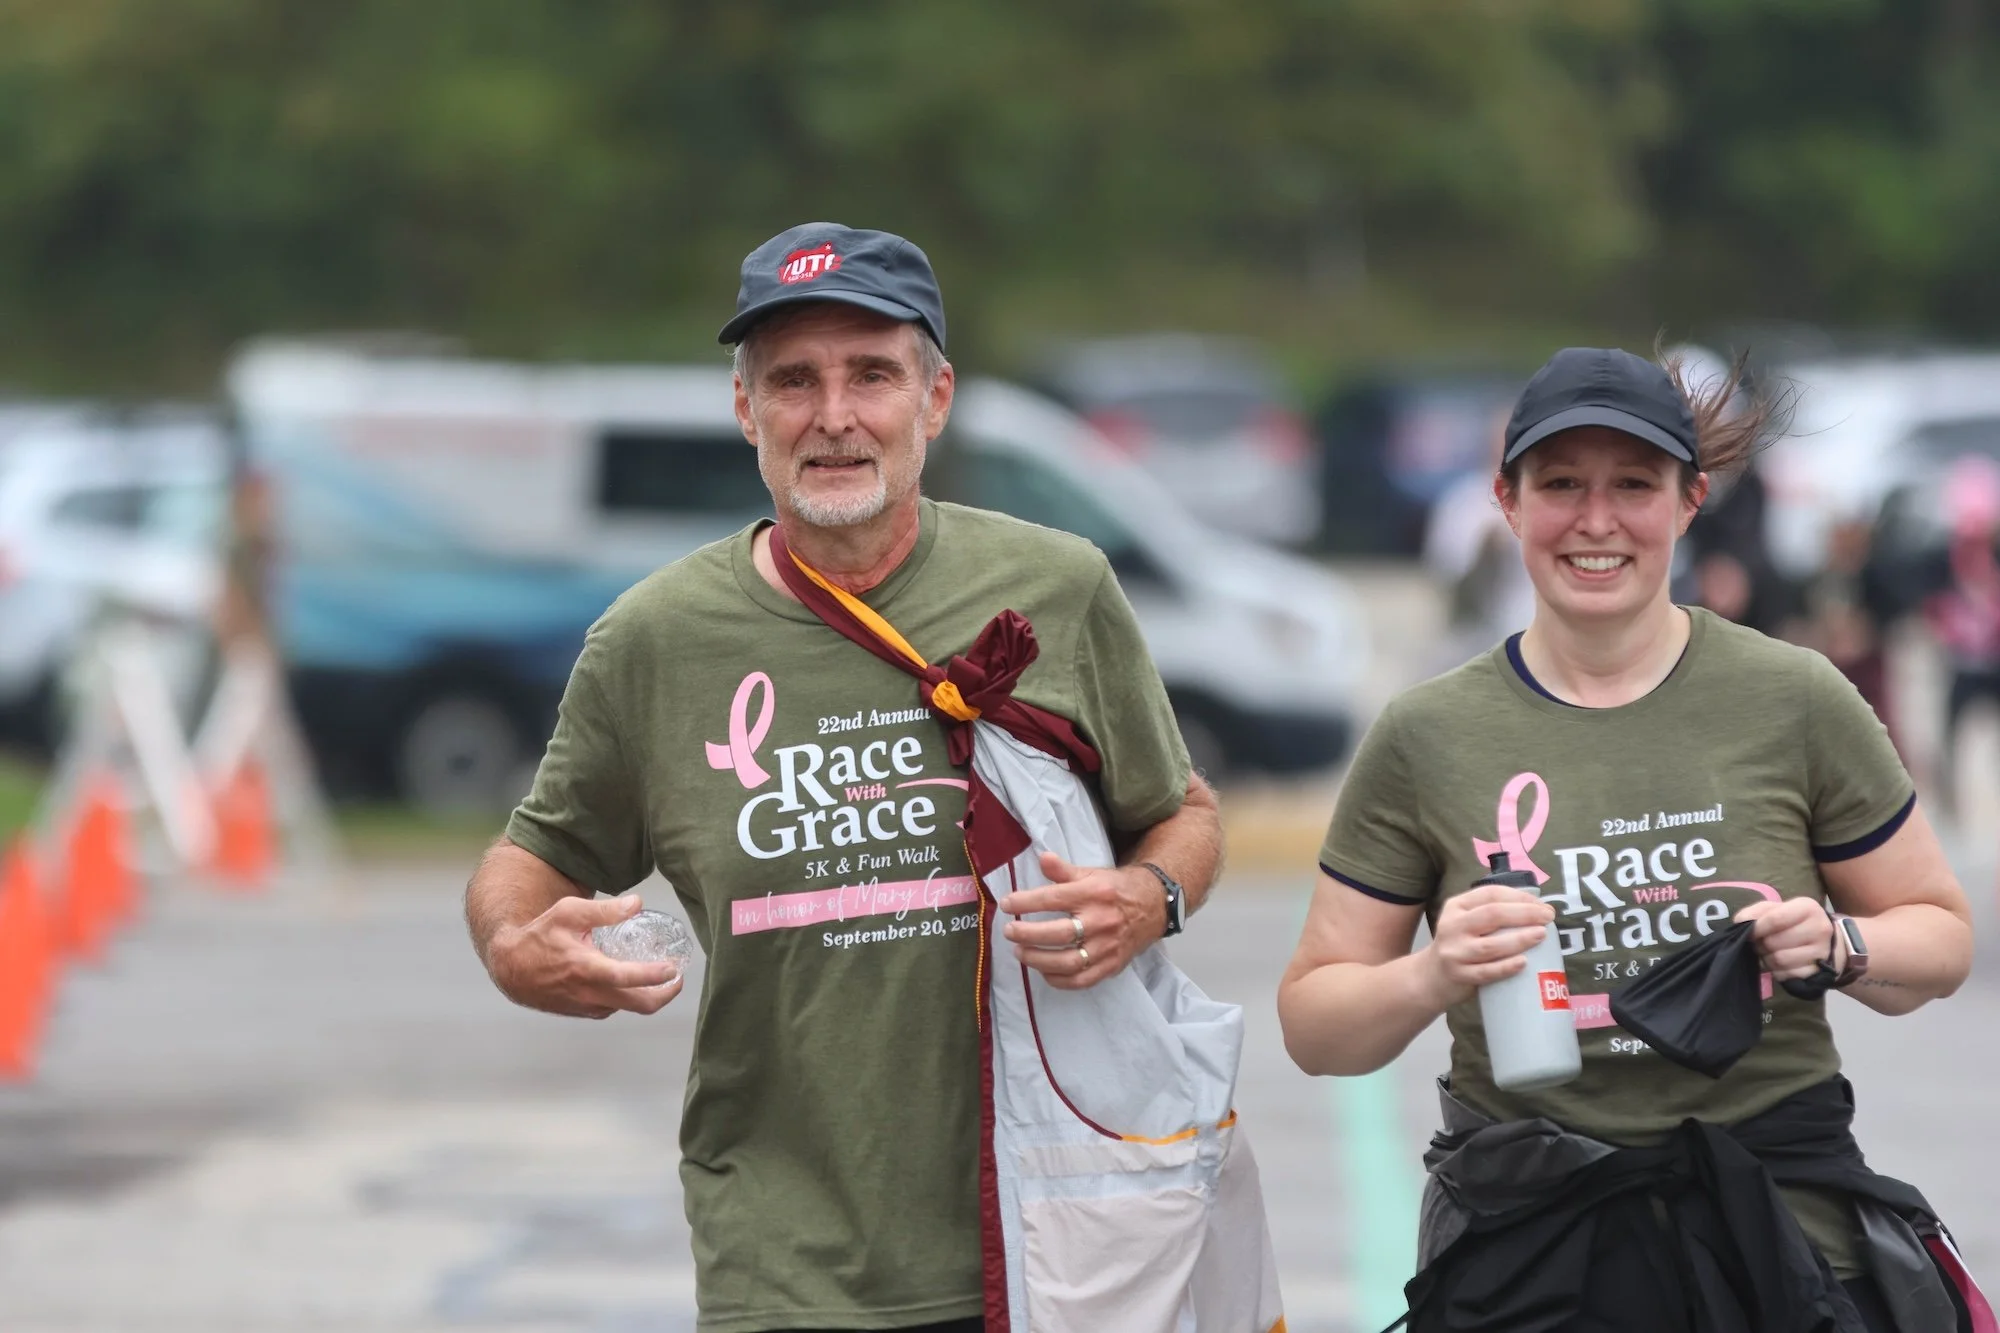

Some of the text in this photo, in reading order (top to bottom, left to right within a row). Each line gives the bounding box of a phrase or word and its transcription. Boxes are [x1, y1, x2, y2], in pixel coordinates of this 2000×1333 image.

[818, 711, 863, 735] 22nd
[774, 737, 924, 813] Race
[844, 783, 887, 802] With
[737, 791, 936, 859] Grace
[1602, 803, 1724, 836] 22nd Annual
[805, 845, 940, 879] 5K & Fun Walk
[1553, 837, 1717, 916] Race
[738, 867, 974, 926] in honor of Mary Grac
[1632, 885, 1679, 904] With
[823, 913, 979, 949] September 20, 202
[1594, 962, 1619, 980] 5K
[1626, 959, 1641, 976] &
